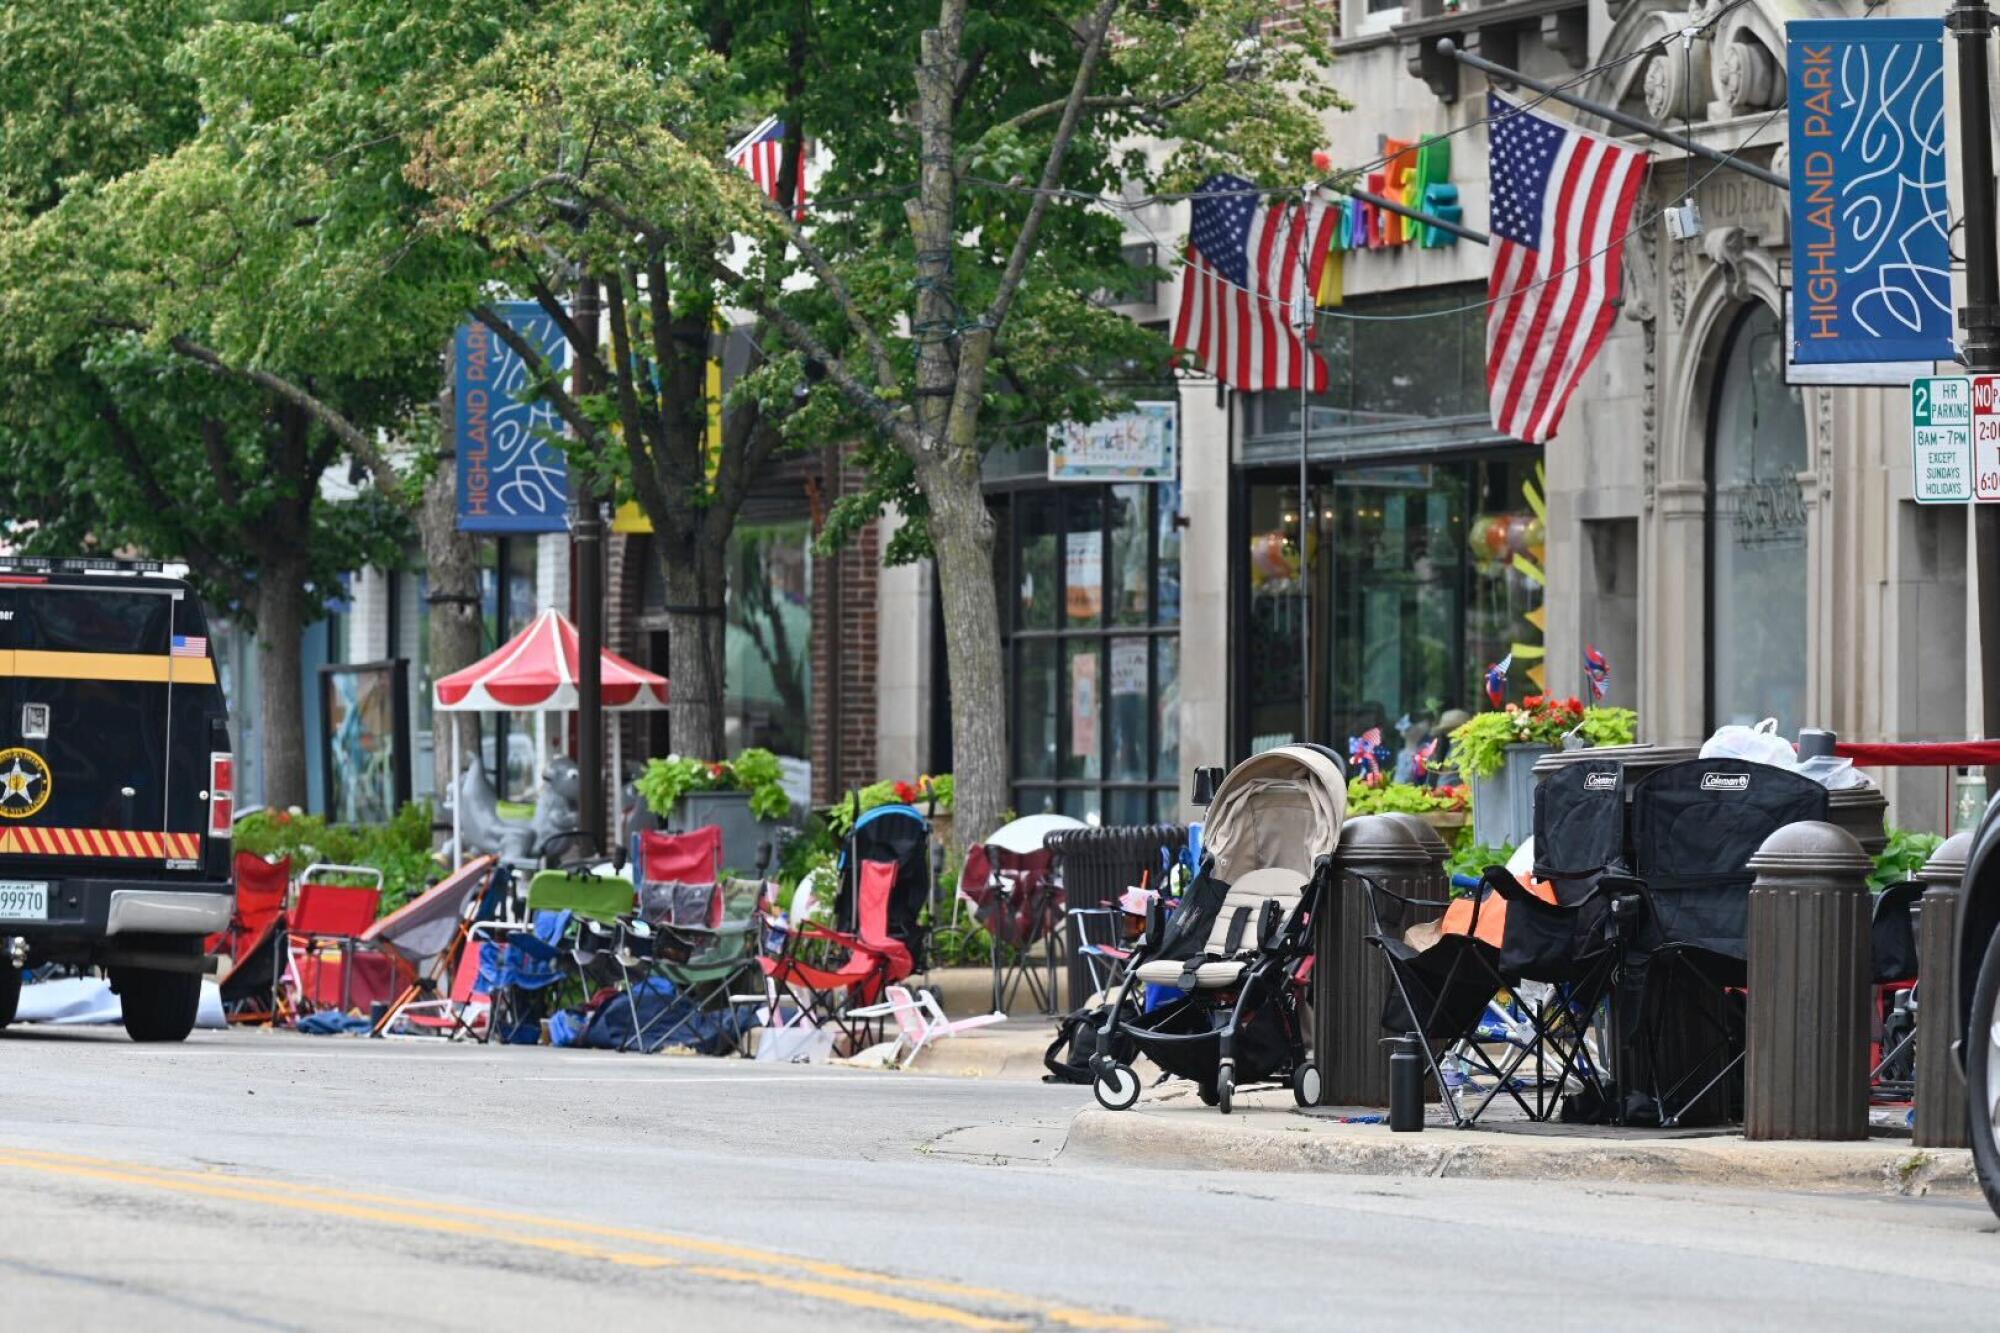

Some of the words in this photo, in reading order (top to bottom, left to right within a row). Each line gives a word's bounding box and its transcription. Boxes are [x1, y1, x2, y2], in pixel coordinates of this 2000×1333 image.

[1803, 46, 1833, 137] PARK
[1806, 151, 1837, 338] HIGHLAND
[1942, 384, 1958, 399] HR
[1975, 384, 1991, 408] NO
[1915, 386, 1928, 417] 2
[1932, 403, 1968, 419] PARKING
[468, 390, 488, 515] HIGHLAND
[1928, 452, 1956, 464] EXCEPT
[1926, 467, 1960, 480] SUNDAYS
[1925, 482, 1961, 495] HOLIDAYS
[1705, 774, 1739, 786] Coleman
